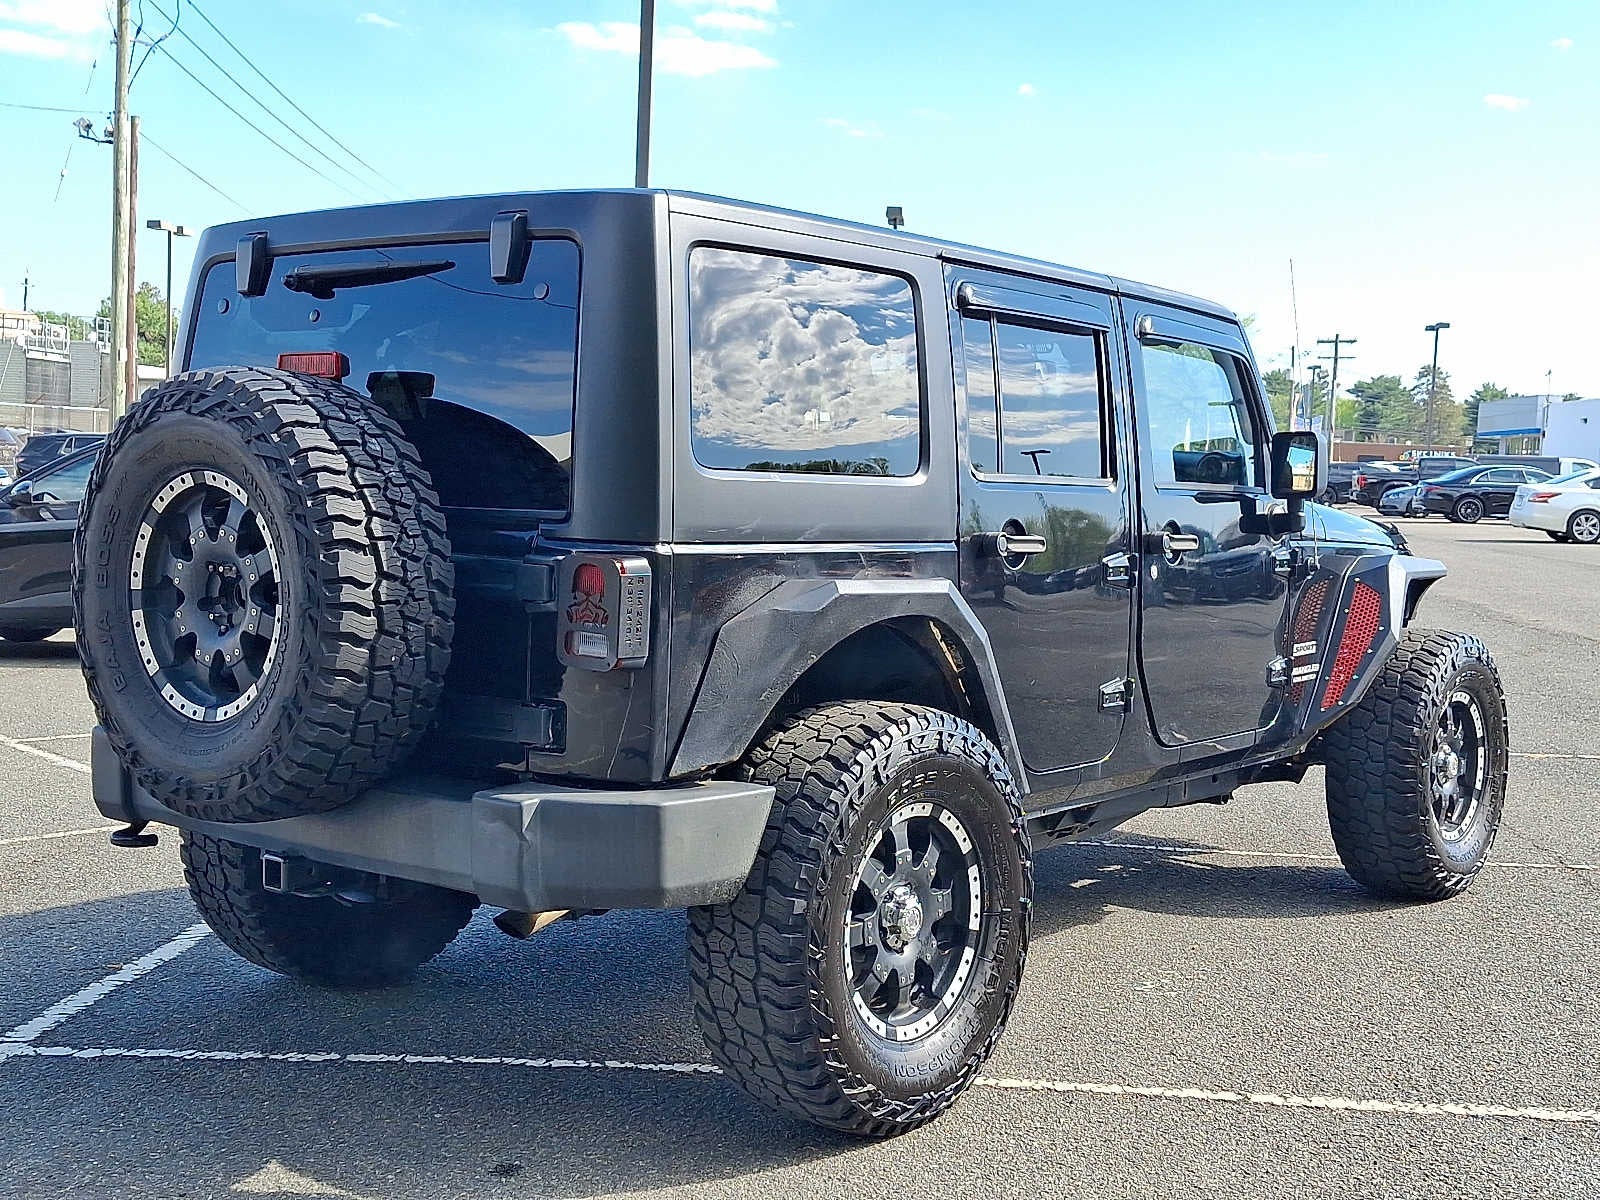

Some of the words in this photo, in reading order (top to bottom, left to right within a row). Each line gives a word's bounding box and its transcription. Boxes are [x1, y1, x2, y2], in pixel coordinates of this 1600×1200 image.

[98, 503, 120, 588] BOSS
[97, 610, 127, 693] BAJA
[1294, 643, 1315, 654] SPORT
[894, 1015, 982, 1078] THOMPSON
